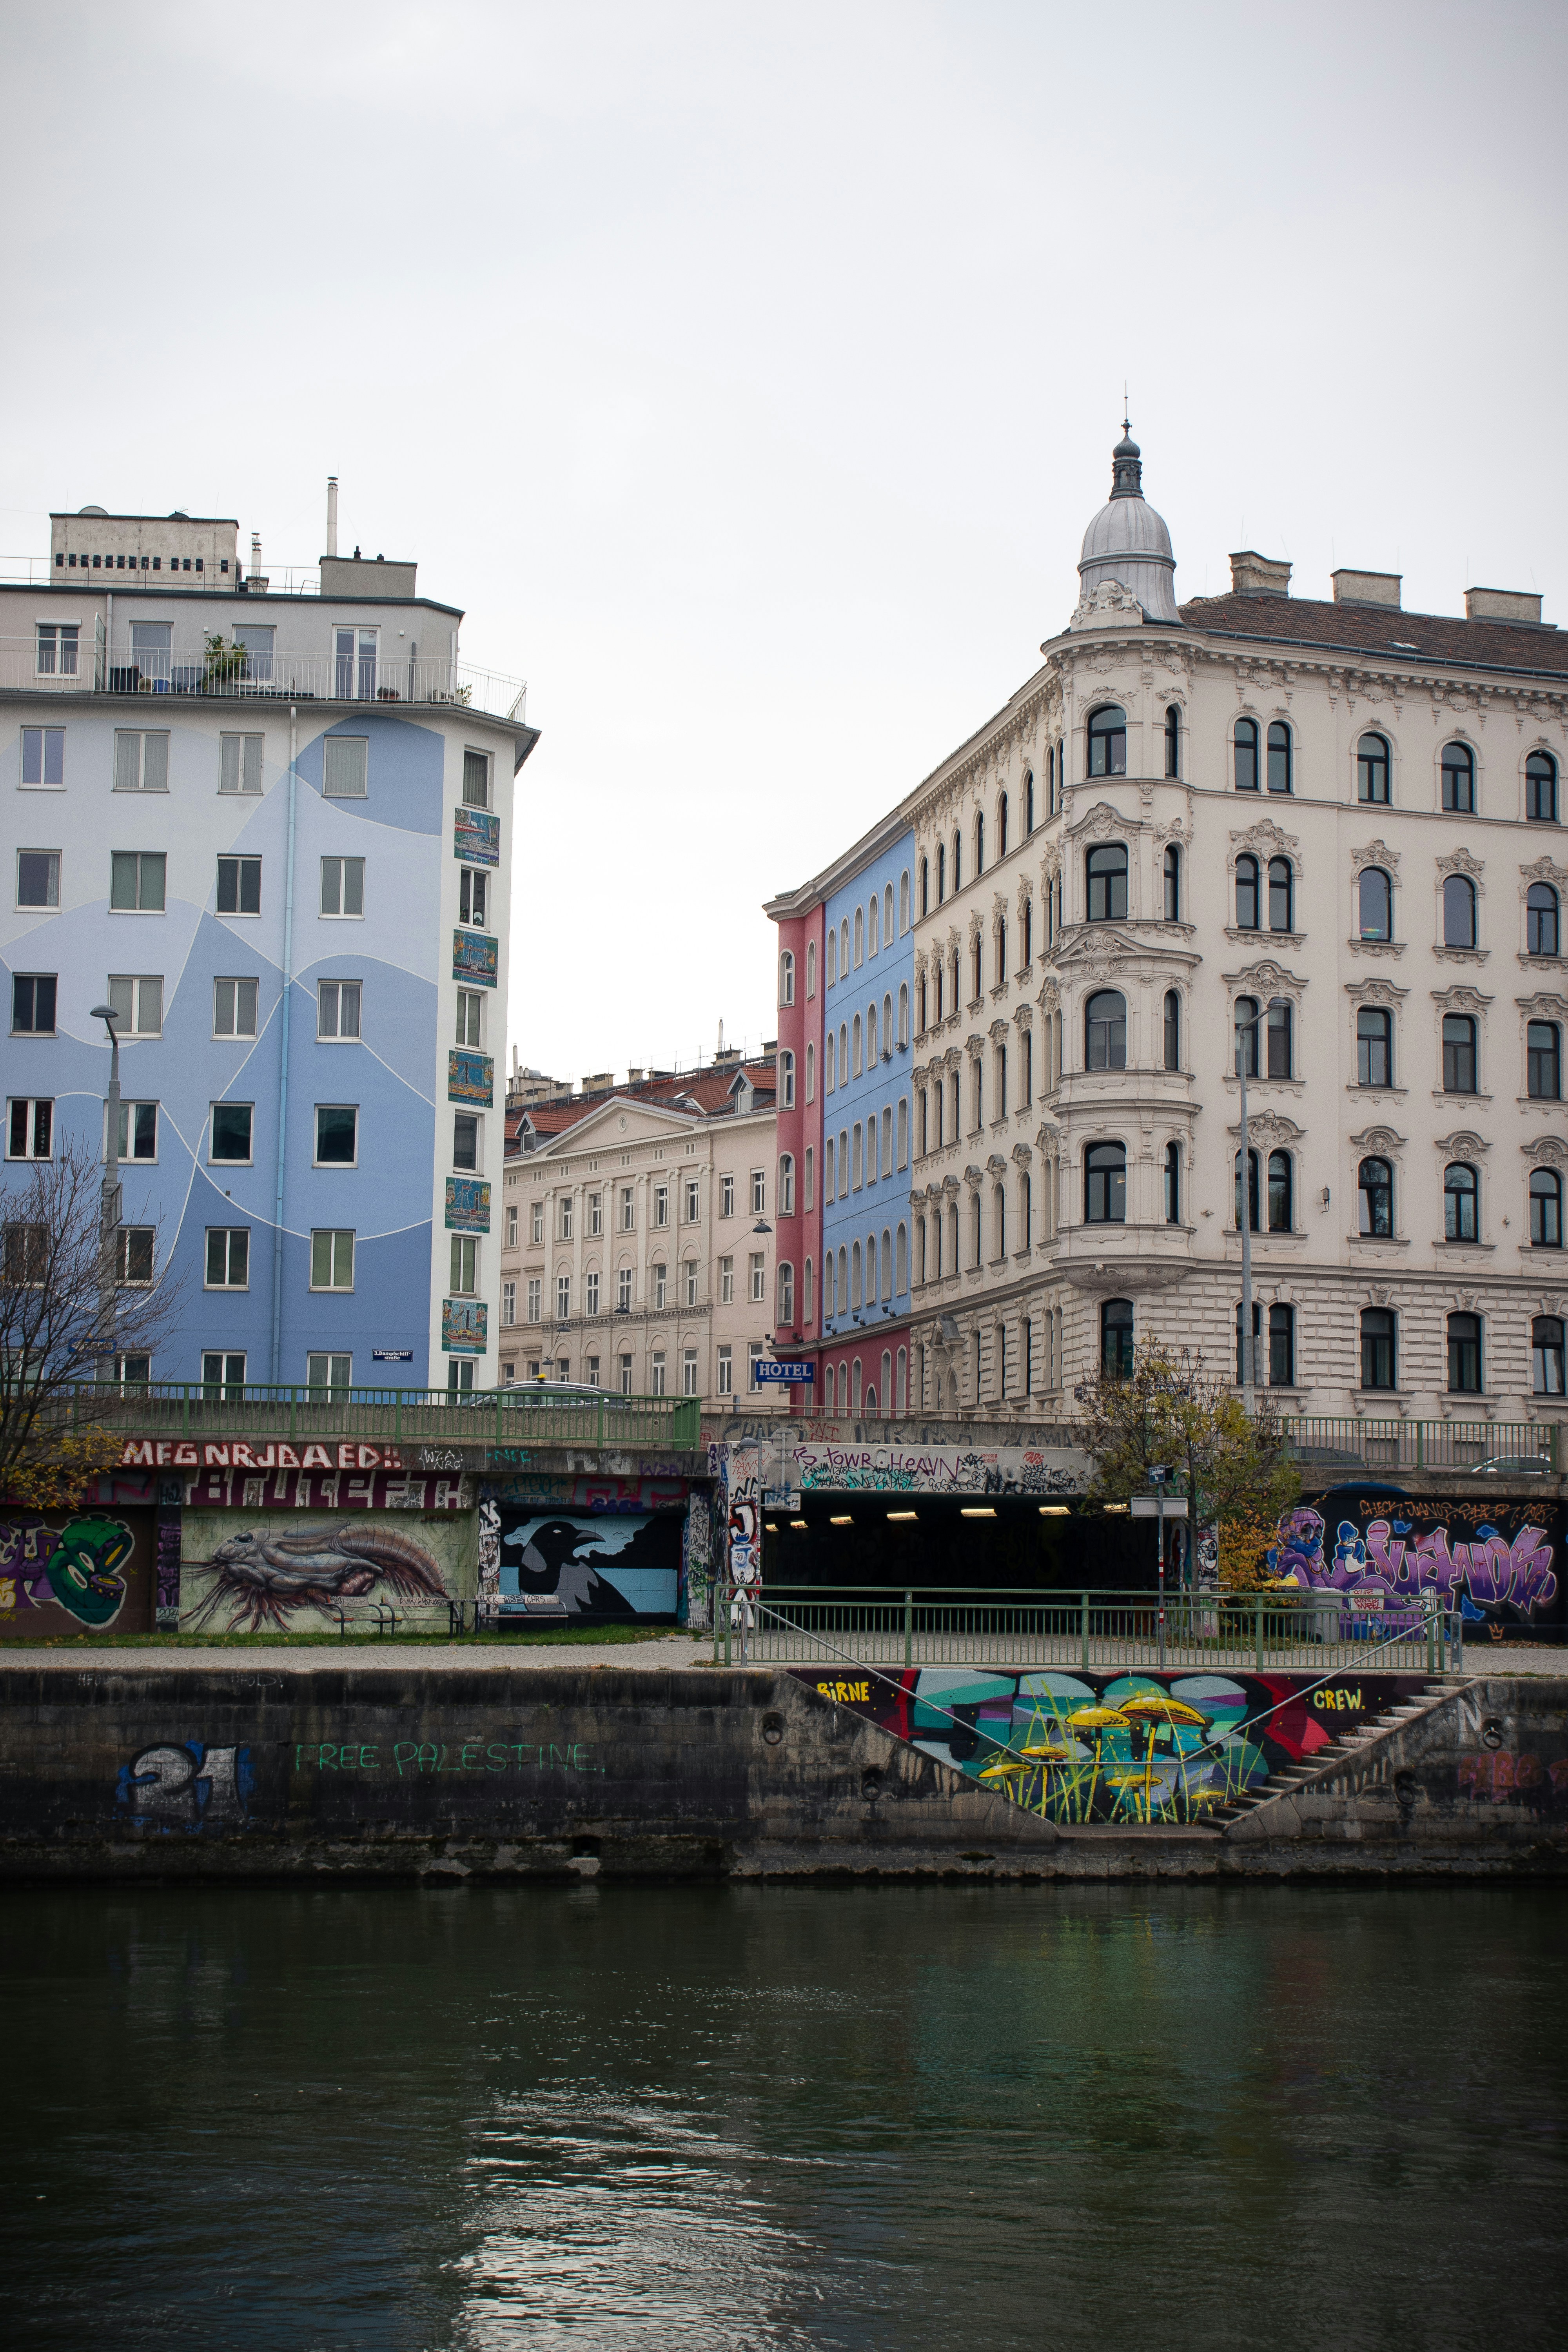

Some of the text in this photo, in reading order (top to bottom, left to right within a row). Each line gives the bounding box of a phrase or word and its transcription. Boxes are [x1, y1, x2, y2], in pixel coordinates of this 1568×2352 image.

[759, 1364, 811, 1377] HOTEL
[527, 1595, 545, 1603] CARS
[817, 1681, 869, 1702] BiRNE
[1313, 1689, 1366, 1710] CREW.
[295, 1743, 380, 1771] FREE
